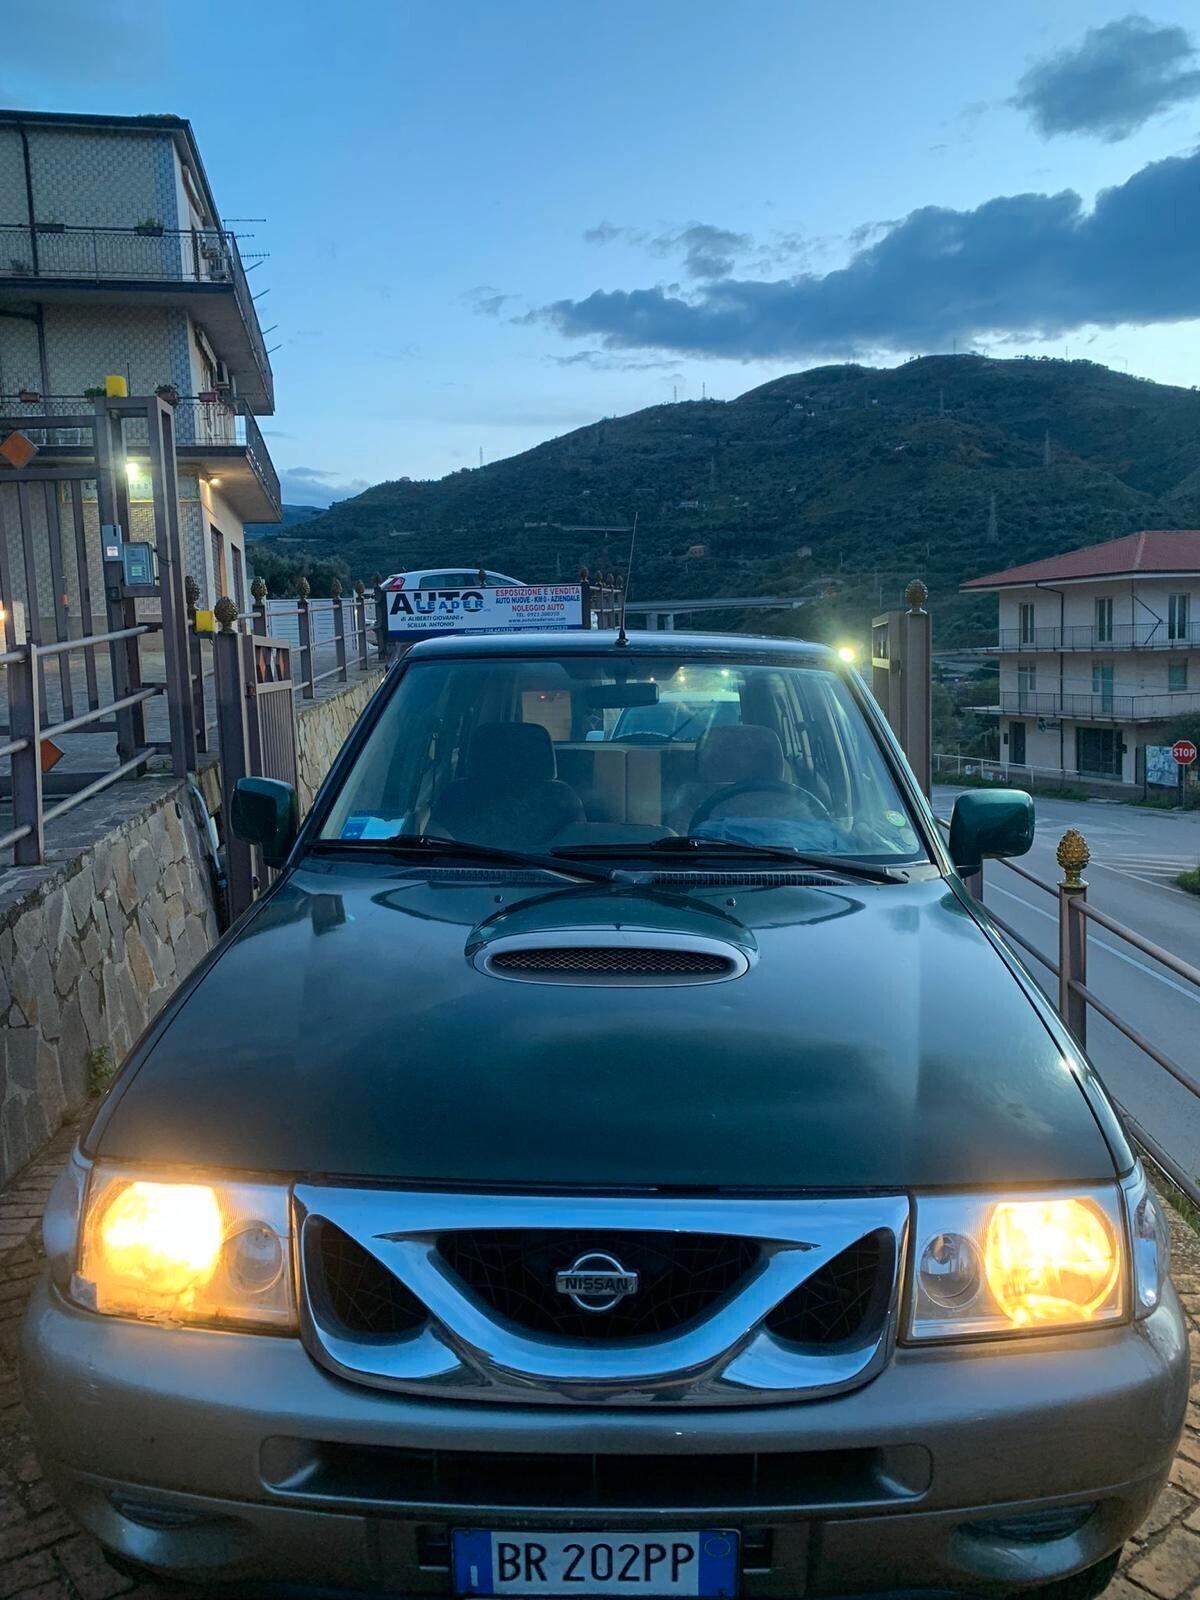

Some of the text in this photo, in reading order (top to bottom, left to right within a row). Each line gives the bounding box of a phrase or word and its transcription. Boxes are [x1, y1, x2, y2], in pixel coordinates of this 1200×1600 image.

[496, 588, 542, 596] ESPOSIZIONE
[550, 587, 580, 595] VENDITA
[389, 591, 484, 615] AUTO
[415, 600, 484, 610] LEADER
[512, 604, 545, 612] NOLEGGIO
[1174, 748, 1195, 757] STOP
[565, 1278, 629, 1290] NISSAN
[496, 1542, 548, 1582] BR
[562, 1542, 695, 1582] 202PP
